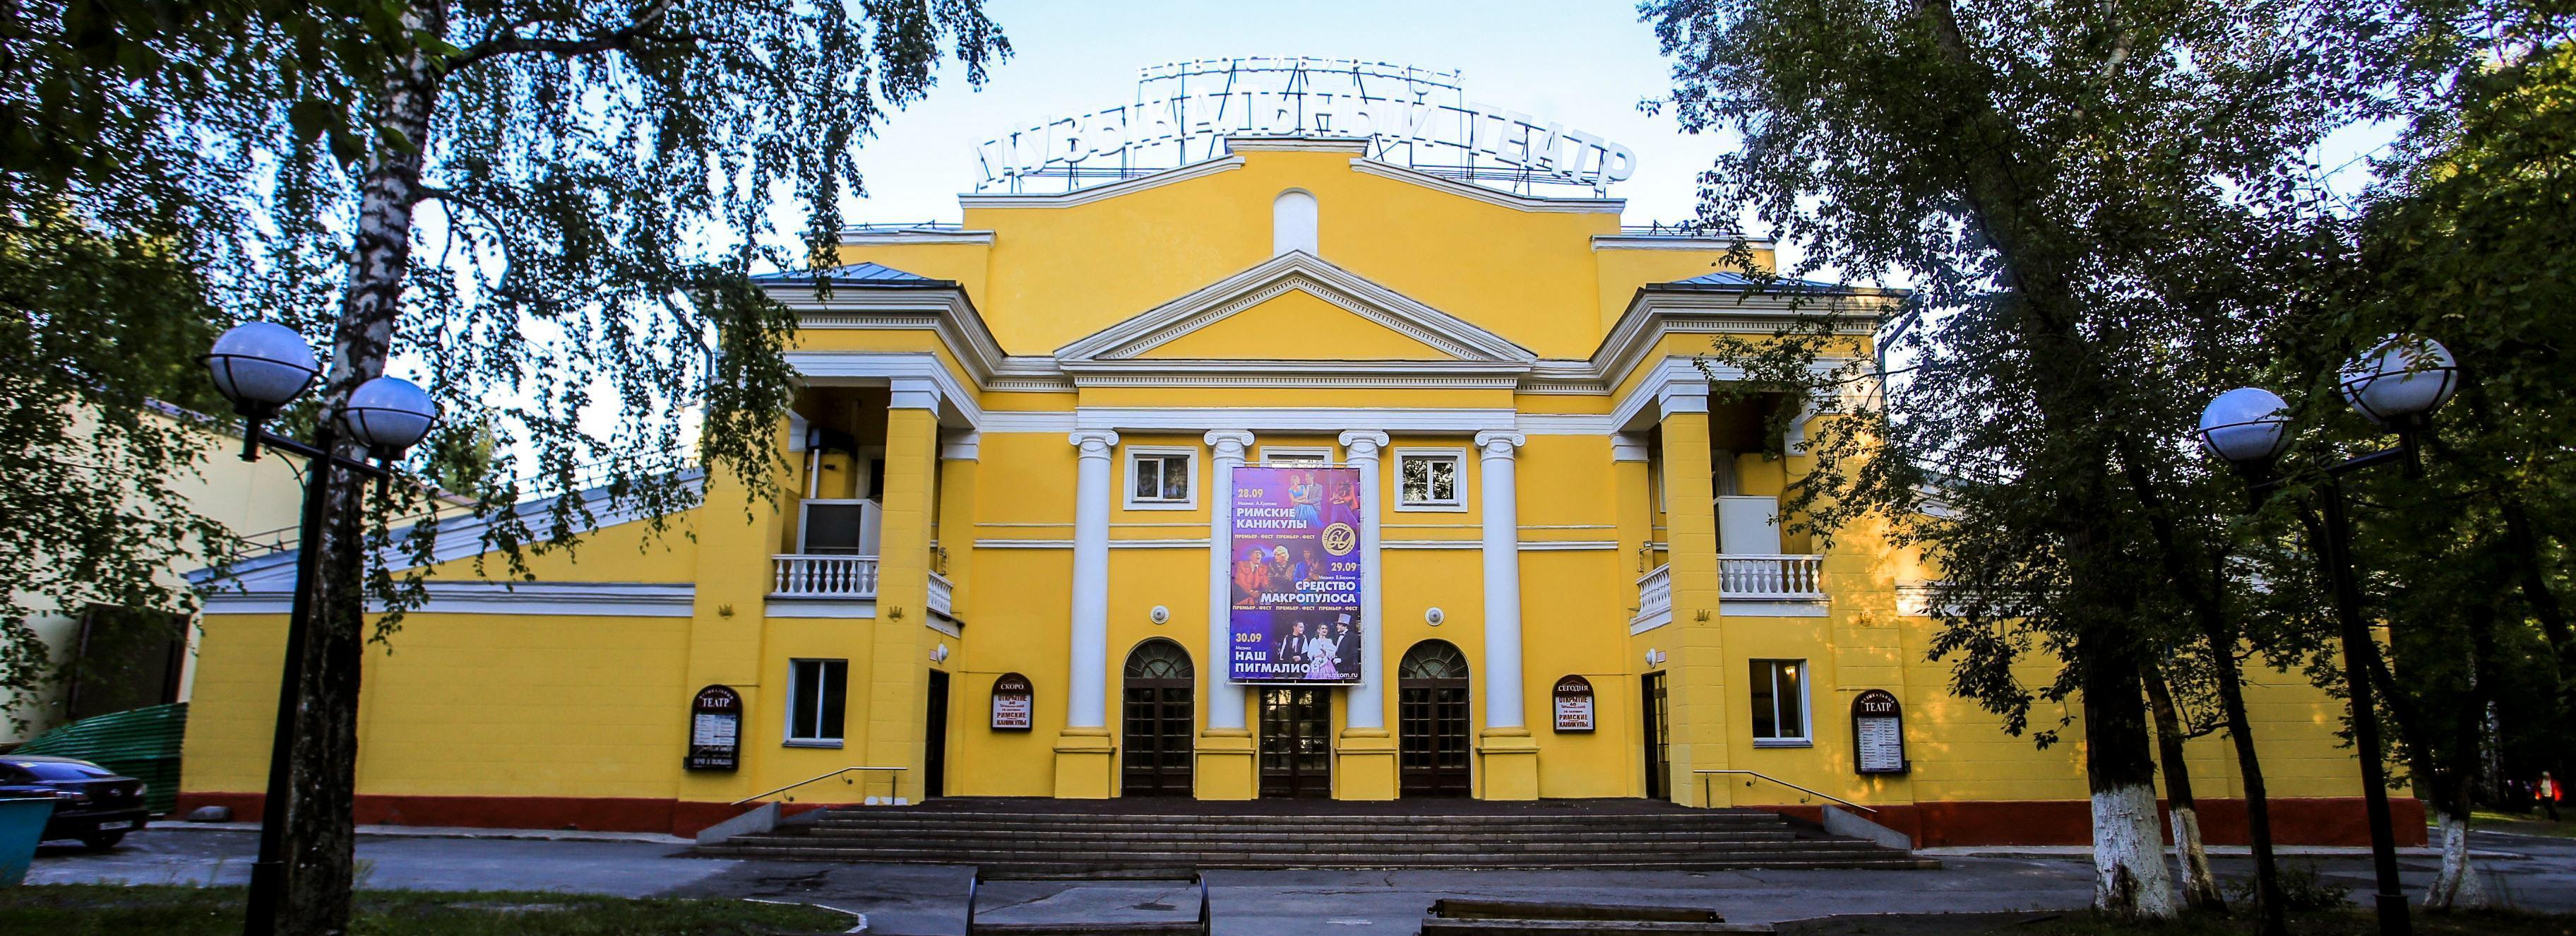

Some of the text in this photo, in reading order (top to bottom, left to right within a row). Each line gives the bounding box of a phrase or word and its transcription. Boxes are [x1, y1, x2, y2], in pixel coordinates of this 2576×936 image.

[1136, 54, 1466, 90] НОВОСИБИРСКИЙ
[967, 79, 1637, 194] МУЗЫКАЛЬНЫЙ ТЕАТР
[1238, 488, 1263, 498] 28.09
[1236, 508, 1296, 518] РИМСКИЕ
[1236, 519, 1307, 529] КАНИКУЛЫ
[1331, 562, 1356, 571] 29.09
[1295, 581, 1356, 592] СРЕДСТВО
[1260, 593, 1356, 603] МАКРОПУЛОСА
[1236, 633, 1262, 643] 30.09
[1236, 651, 1266, 660] НАШ
[1236, 663, 1320, 673] ПИГМАЛИОН
[702, 697, 729, 707] ТЕАТР
[1864, 702, 1891, 711] ТЕАТР
